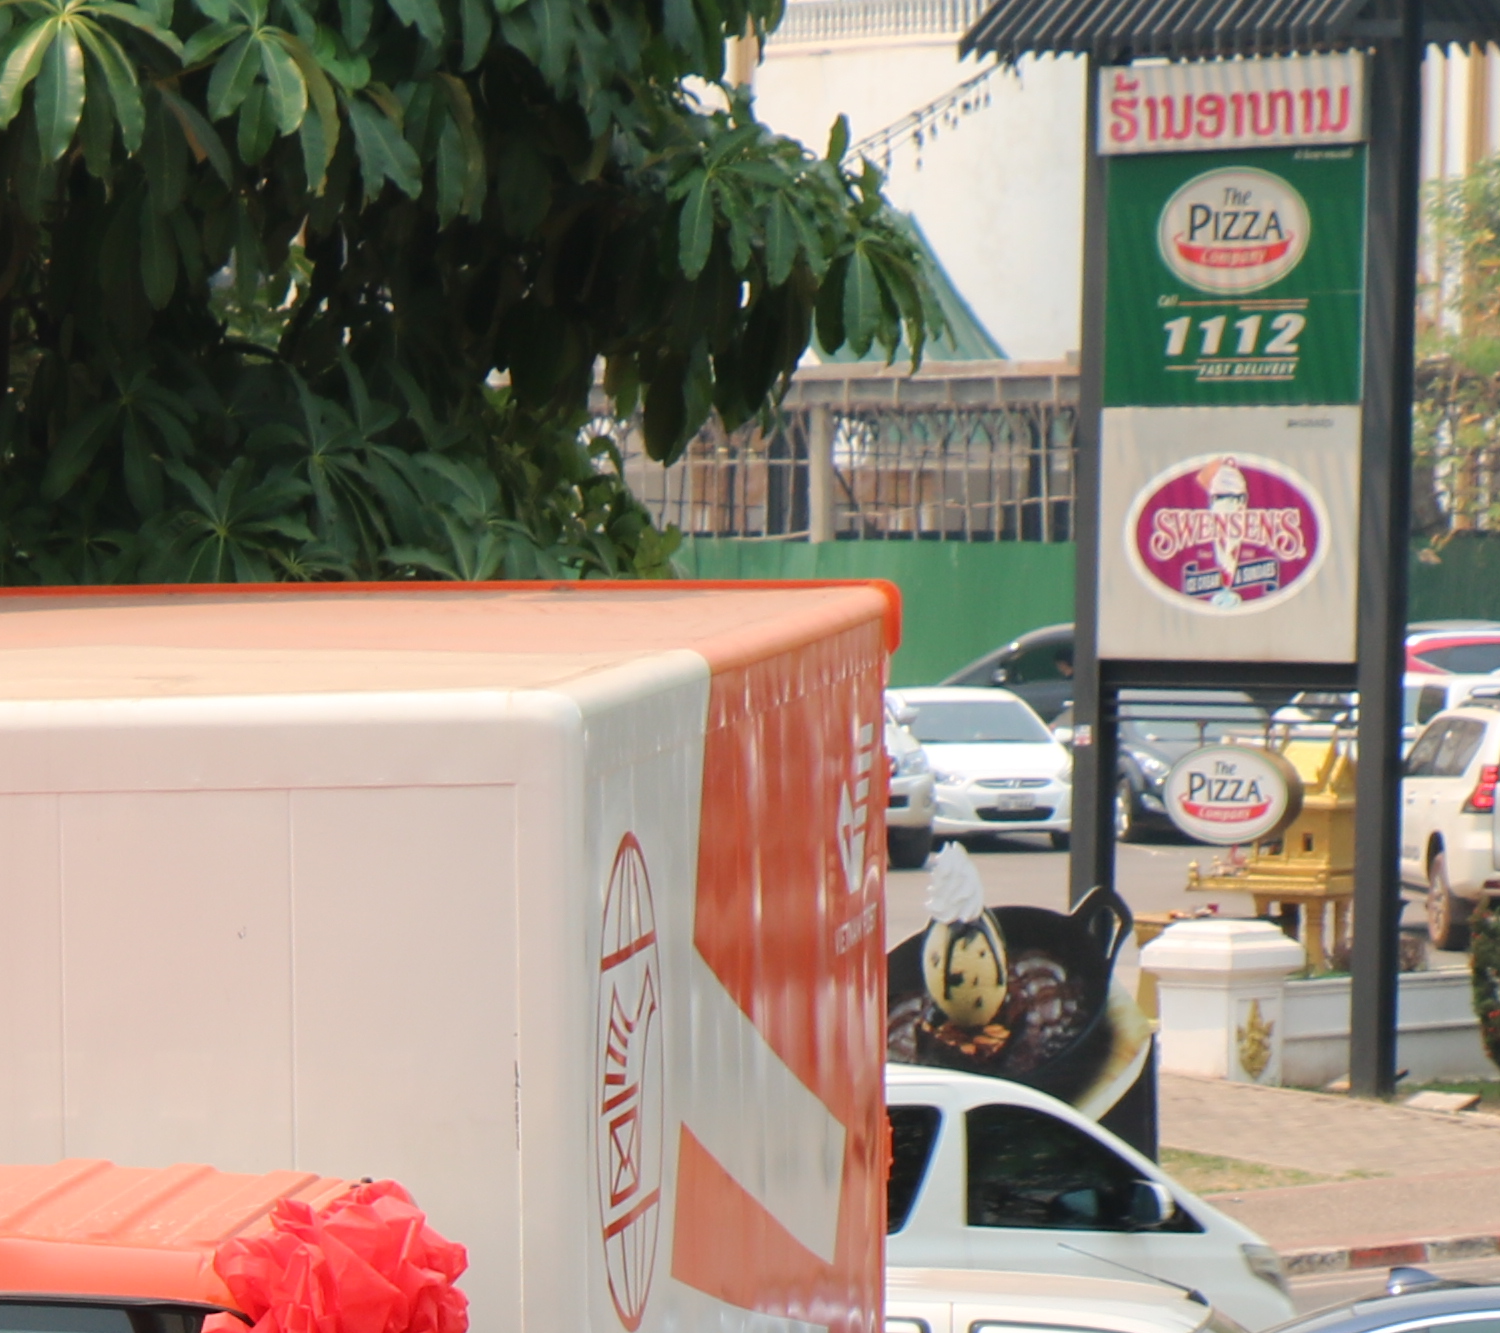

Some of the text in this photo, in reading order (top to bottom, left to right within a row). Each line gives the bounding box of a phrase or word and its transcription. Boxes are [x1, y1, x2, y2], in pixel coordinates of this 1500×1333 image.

[1110, 73, 1350, 142] ຮ້ານອາຫານ
[1223, 187, 1252, 206] The
[1188, 203, 1284, 242] PIZZA
[1163, 313, 1307, 356] 1112
[1199, 362, 1297, 376] FAST DELIVERY
[1214, 761, 1237, 776] The
[1188, 771, 1262, 802] PIZZA
